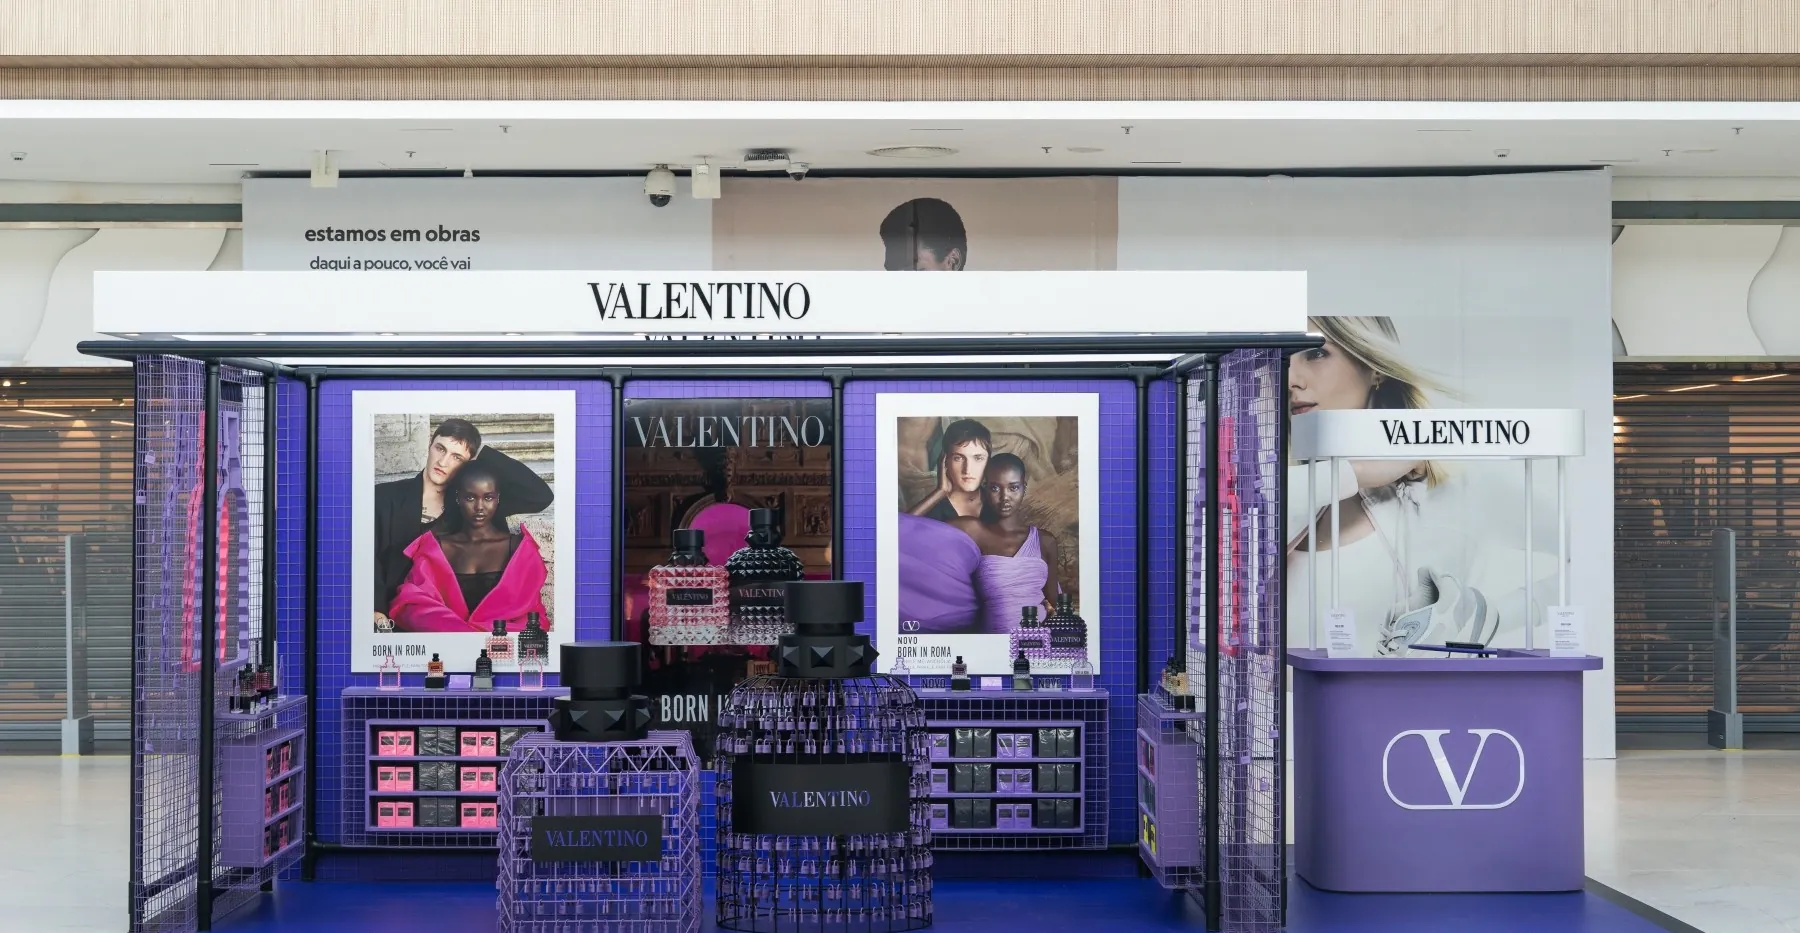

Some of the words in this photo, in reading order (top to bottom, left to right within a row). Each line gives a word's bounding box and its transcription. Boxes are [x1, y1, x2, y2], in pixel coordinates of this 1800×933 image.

[305, 226, 386, 242] estamos
[390, 229, 421, 242] em
[425, 225, 481, 242] obras
[310, 256, 351, 271] daqui
[353, 259, 362, 270] a
[364, 259, 412, 271] pouco,
[414, 257, 448, 270] você
[450, 257, 471, 270] vai
[587, 282, 811, 321] VALENTINO
[630, 415, 825, 449] VALENTINO
[1380, 420, 1530, 445] VALENTINO
[897, 636, 918, 645] NOVO
[372, 644, 392, 657] BORN
[395, 644, 403, 656] IN
[405, 644, 426, 656] ROMA
[897, 646, 917, 658] BORN
[920, 646, 928, 658] IN
[930, 646, 952, 658] ROMA
[921, 678, 946, 689] NOVO
[661, 694, 709, 722] BORN
[769, 790, 871, 808] VALENTINO
[546, 830, 648, 847] VALENTINO
